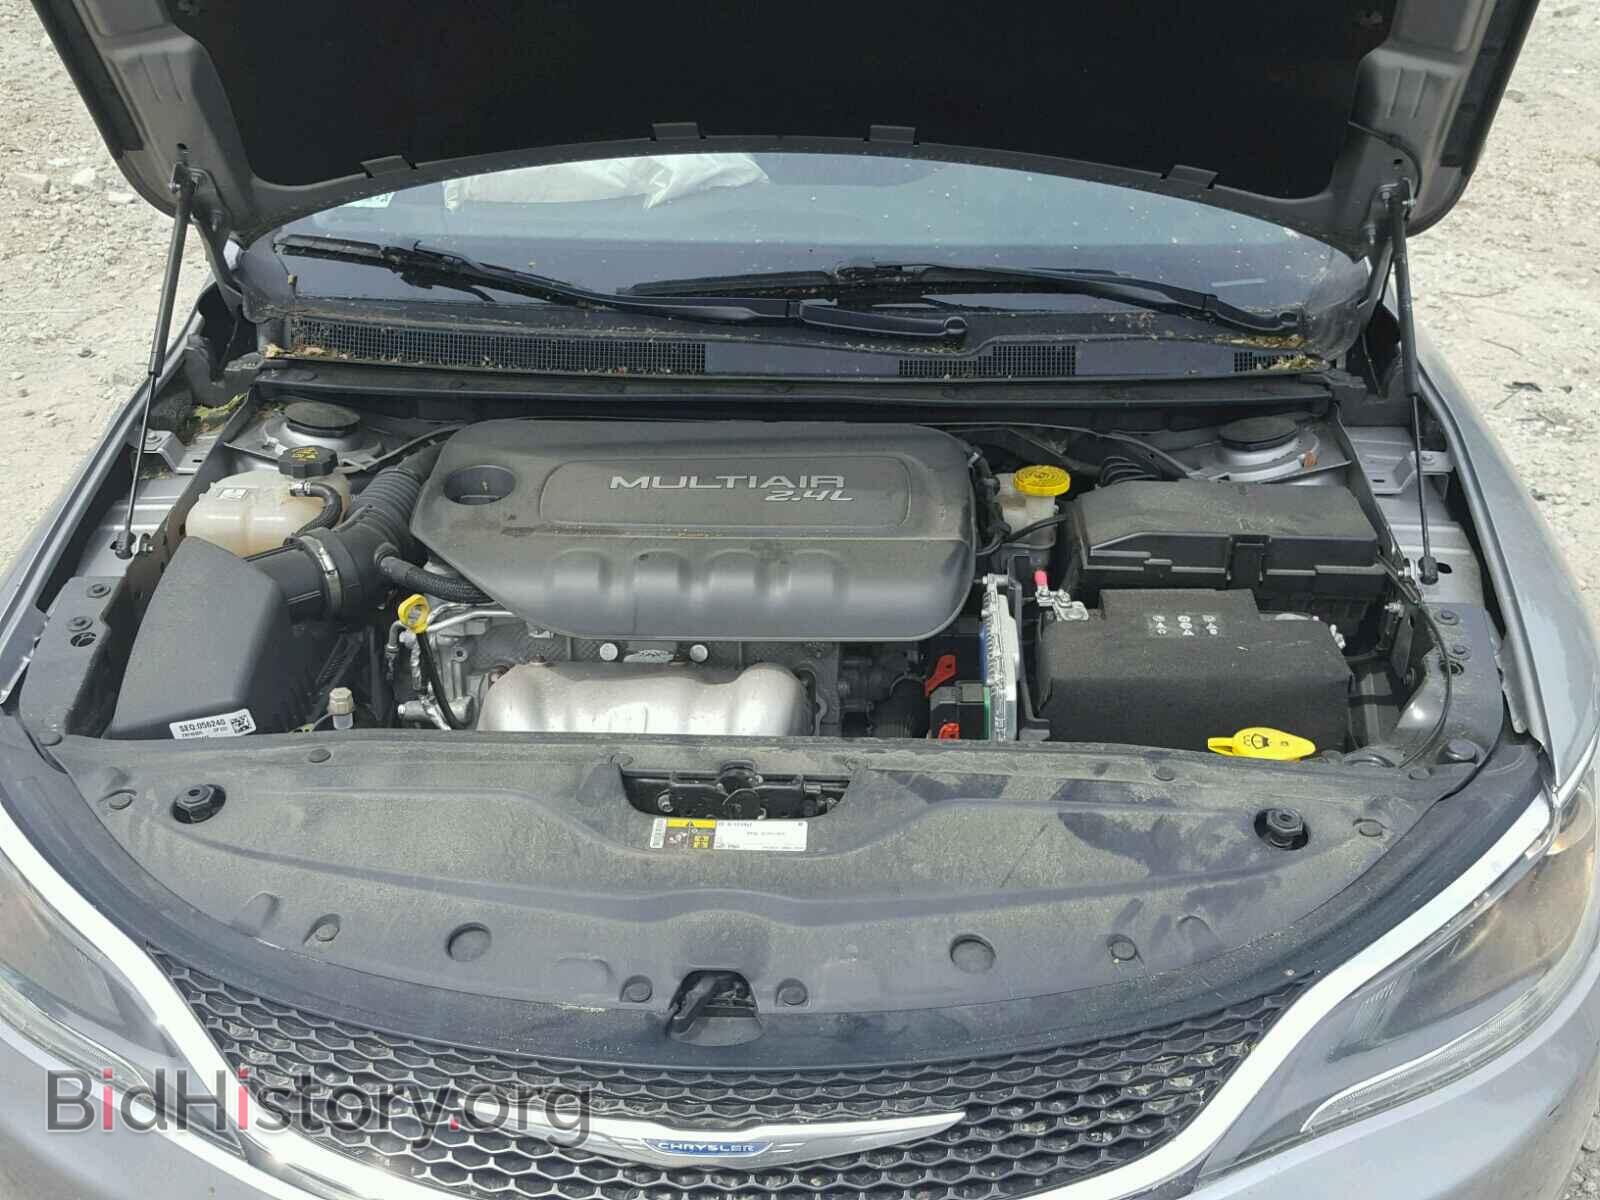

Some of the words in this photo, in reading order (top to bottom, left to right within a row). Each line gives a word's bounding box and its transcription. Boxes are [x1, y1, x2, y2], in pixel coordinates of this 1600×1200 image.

[610, 475, 845, 489] MULTIAIR
[764, 489, 853, 501] 2.4L
[658, 1142, 754, 1153] CHRYSLER
